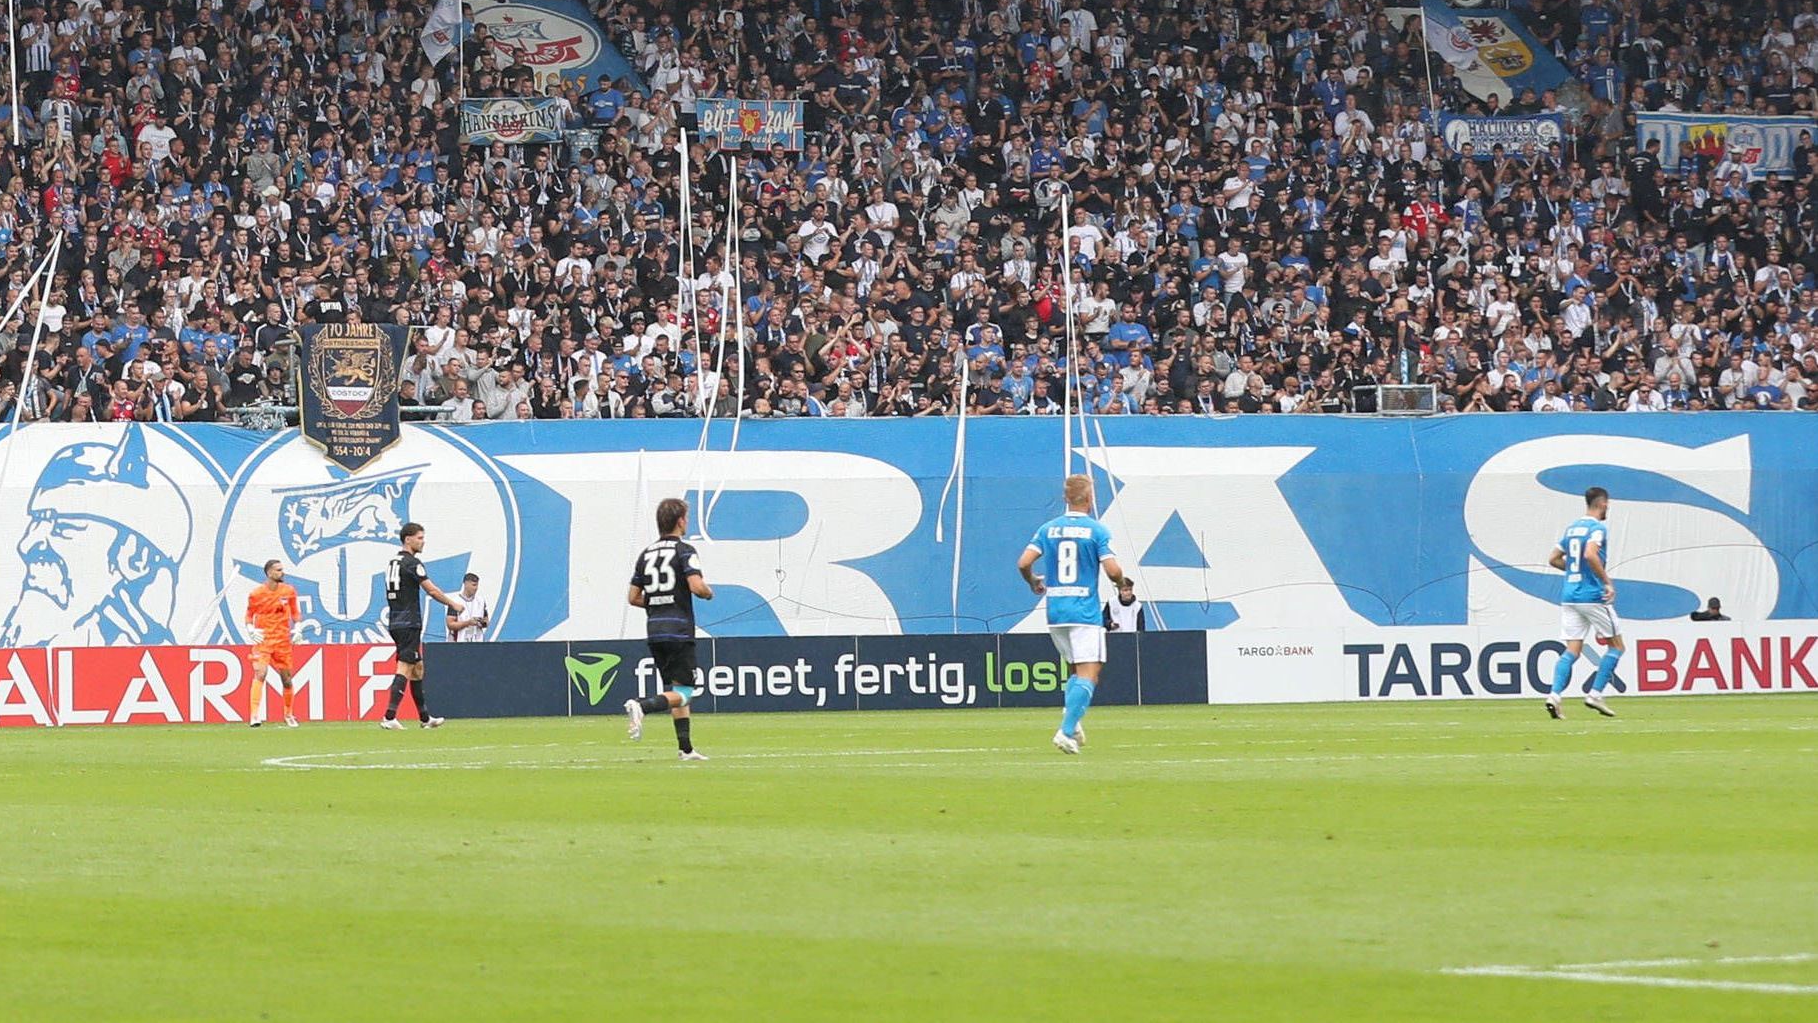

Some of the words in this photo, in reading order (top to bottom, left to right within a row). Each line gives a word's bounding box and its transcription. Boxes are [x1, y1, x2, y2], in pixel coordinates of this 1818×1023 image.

[461, 104, 556, 135] HANSASKINS
[703, 101, 735, 134] BÜT
[329, 323, 343, 338] 70
[345, 322, 375, 339] JAHRE
[643, 549, 677, 594] 33
[1058, 540, 1078, 584] 8
[1569, 538, 1581, 573] 9
[834, 653, 978, 706] fertig,
